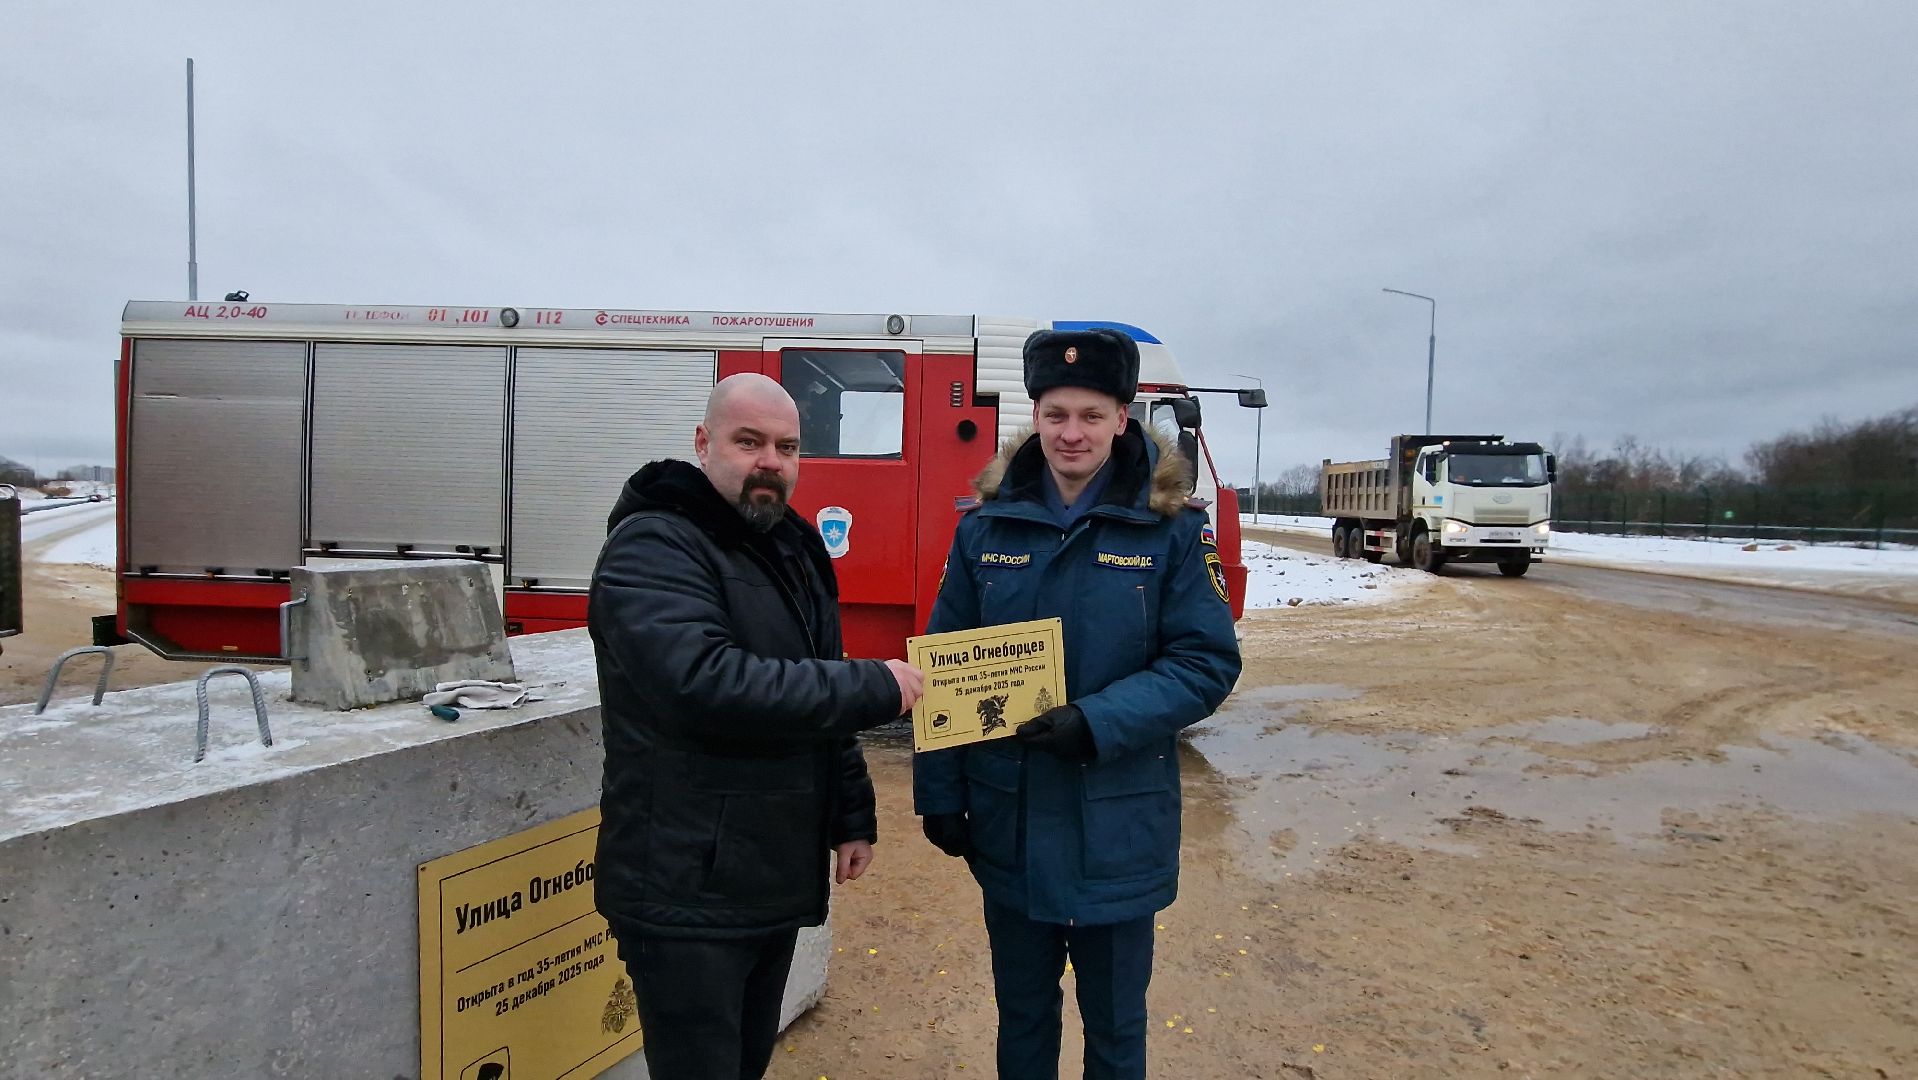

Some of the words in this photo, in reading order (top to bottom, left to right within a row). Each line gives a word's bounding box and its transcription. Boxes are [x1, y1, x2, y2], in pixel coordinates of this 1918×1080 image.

[184, 305, 209, 320] АЦ
[428, 308, 447, 322] 01
[536, 311, 563, 324] 112
[610, 314, 690, 326] СПЕЦТЕХНИКА
[712, 316, 814, 328] ПОЖАРОТУШЕНИЯ
[981, 553, 999, 563] МЧС
[999, 553, 1031, 565] РОССИИ
[1097, 551, 1141, 567] МАРТОВСКИЙ
[930, 650, 969, 668] Улица
[973, 640, 1045, 661] Огнеборцев
[932, 677, 960, 688] Открыта
[1009, 666, 1024, 676] МЧС
[1024, 663, 1046, 674] России
[955, 687, 963, 697] 25
[964, 684, 992, 696] декабря
[993, 680, 1009, 690] 2025
[1010, 679, 1025, 687] года
[456, 891, 522, 934] Улица
[529, 860, 595, 904] Огнебо
[457, 981, 504, 1013] Открыта
[508, 977, 515, 989] в
[517, 970, 534, 985] год
[536, 945, 582, 975] 35-летия
[583, 931, 603, 952] МЧС
[495, 1001, 509, 1017] 25
[511, 980, 556, 1011] декабря
[558, 962, 582, 985] 2025
[583, 954, 605, 972] года
